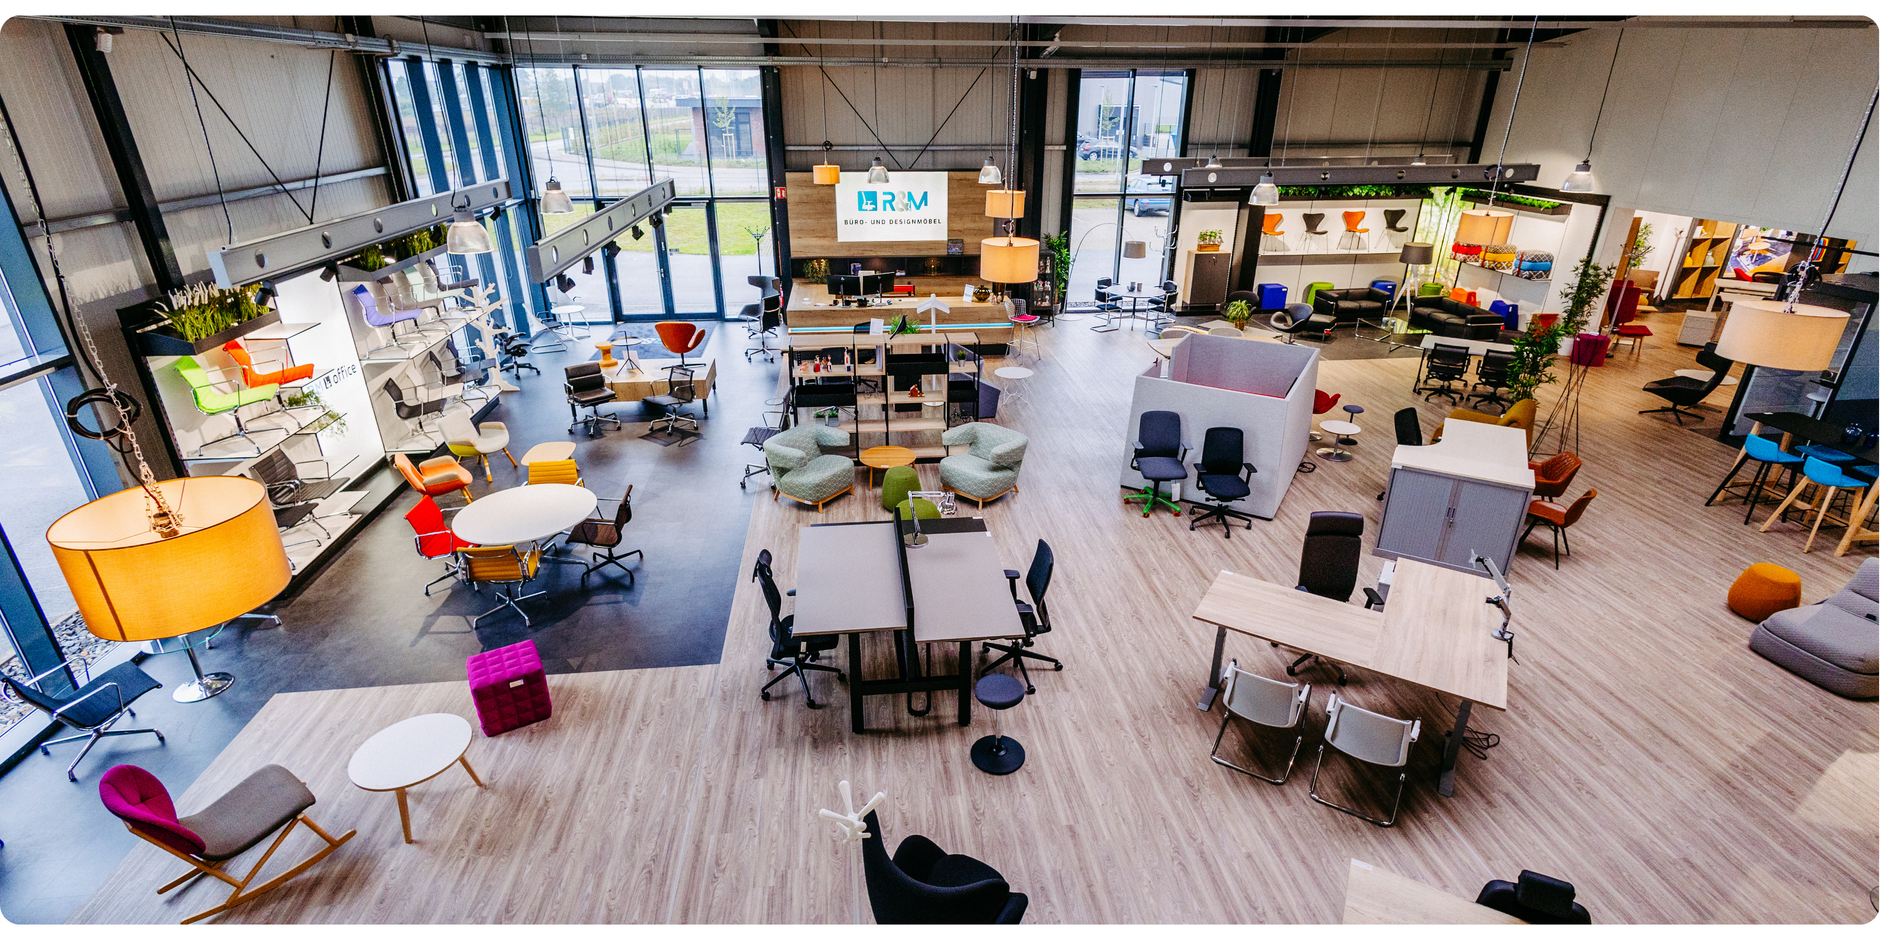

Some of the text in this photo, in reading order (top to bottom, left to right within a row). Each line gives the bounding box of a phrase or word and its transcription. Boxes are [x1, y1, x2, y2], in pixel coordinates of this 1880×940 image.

[882, 191, 928, 212] R&M
[844, 218, 868, 226] BÜRO-
[889, 218, 942, 226] DESIGNMÖBEL
[332, 364, 357, 384] office
